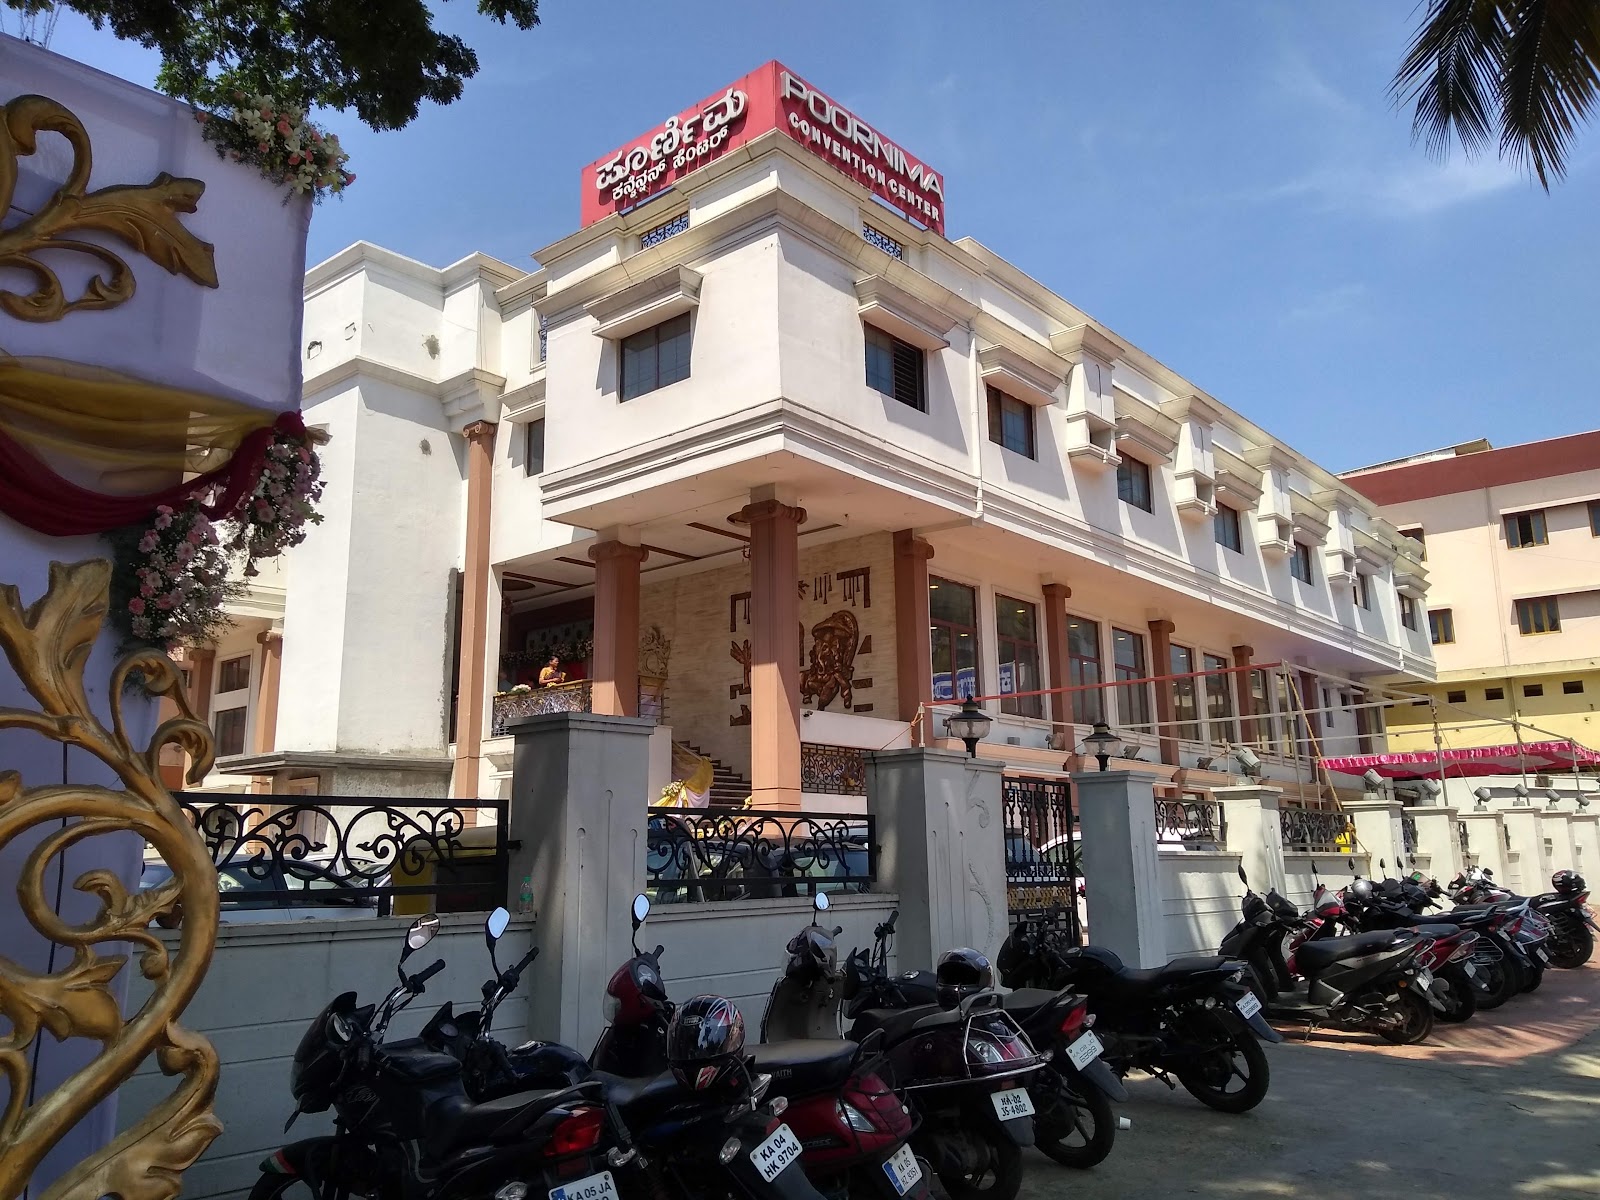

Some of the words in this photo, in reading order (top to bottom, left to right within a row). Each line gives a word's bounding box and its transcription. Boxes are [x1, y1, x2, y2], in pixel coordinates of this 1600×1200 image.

[673, 125, 729, 169] ಸೆಂಟರ್
[780, 71, 944, 202] POORNIMA
[788, 112, 886, 186] CONVENTION
[887, 178, 940, 222] CENTER
[759, 1145, 776, 1162] KA
[773, 1134, 787, 1149] 04
[763, 1160, 780, 1178] HK
[777, 1141, 799, 1165] 9704
[897, 1162, 906, 1174] KA
[584, 1186, 597, 1199] 05
[598, 1181, 613, 1194] JA
